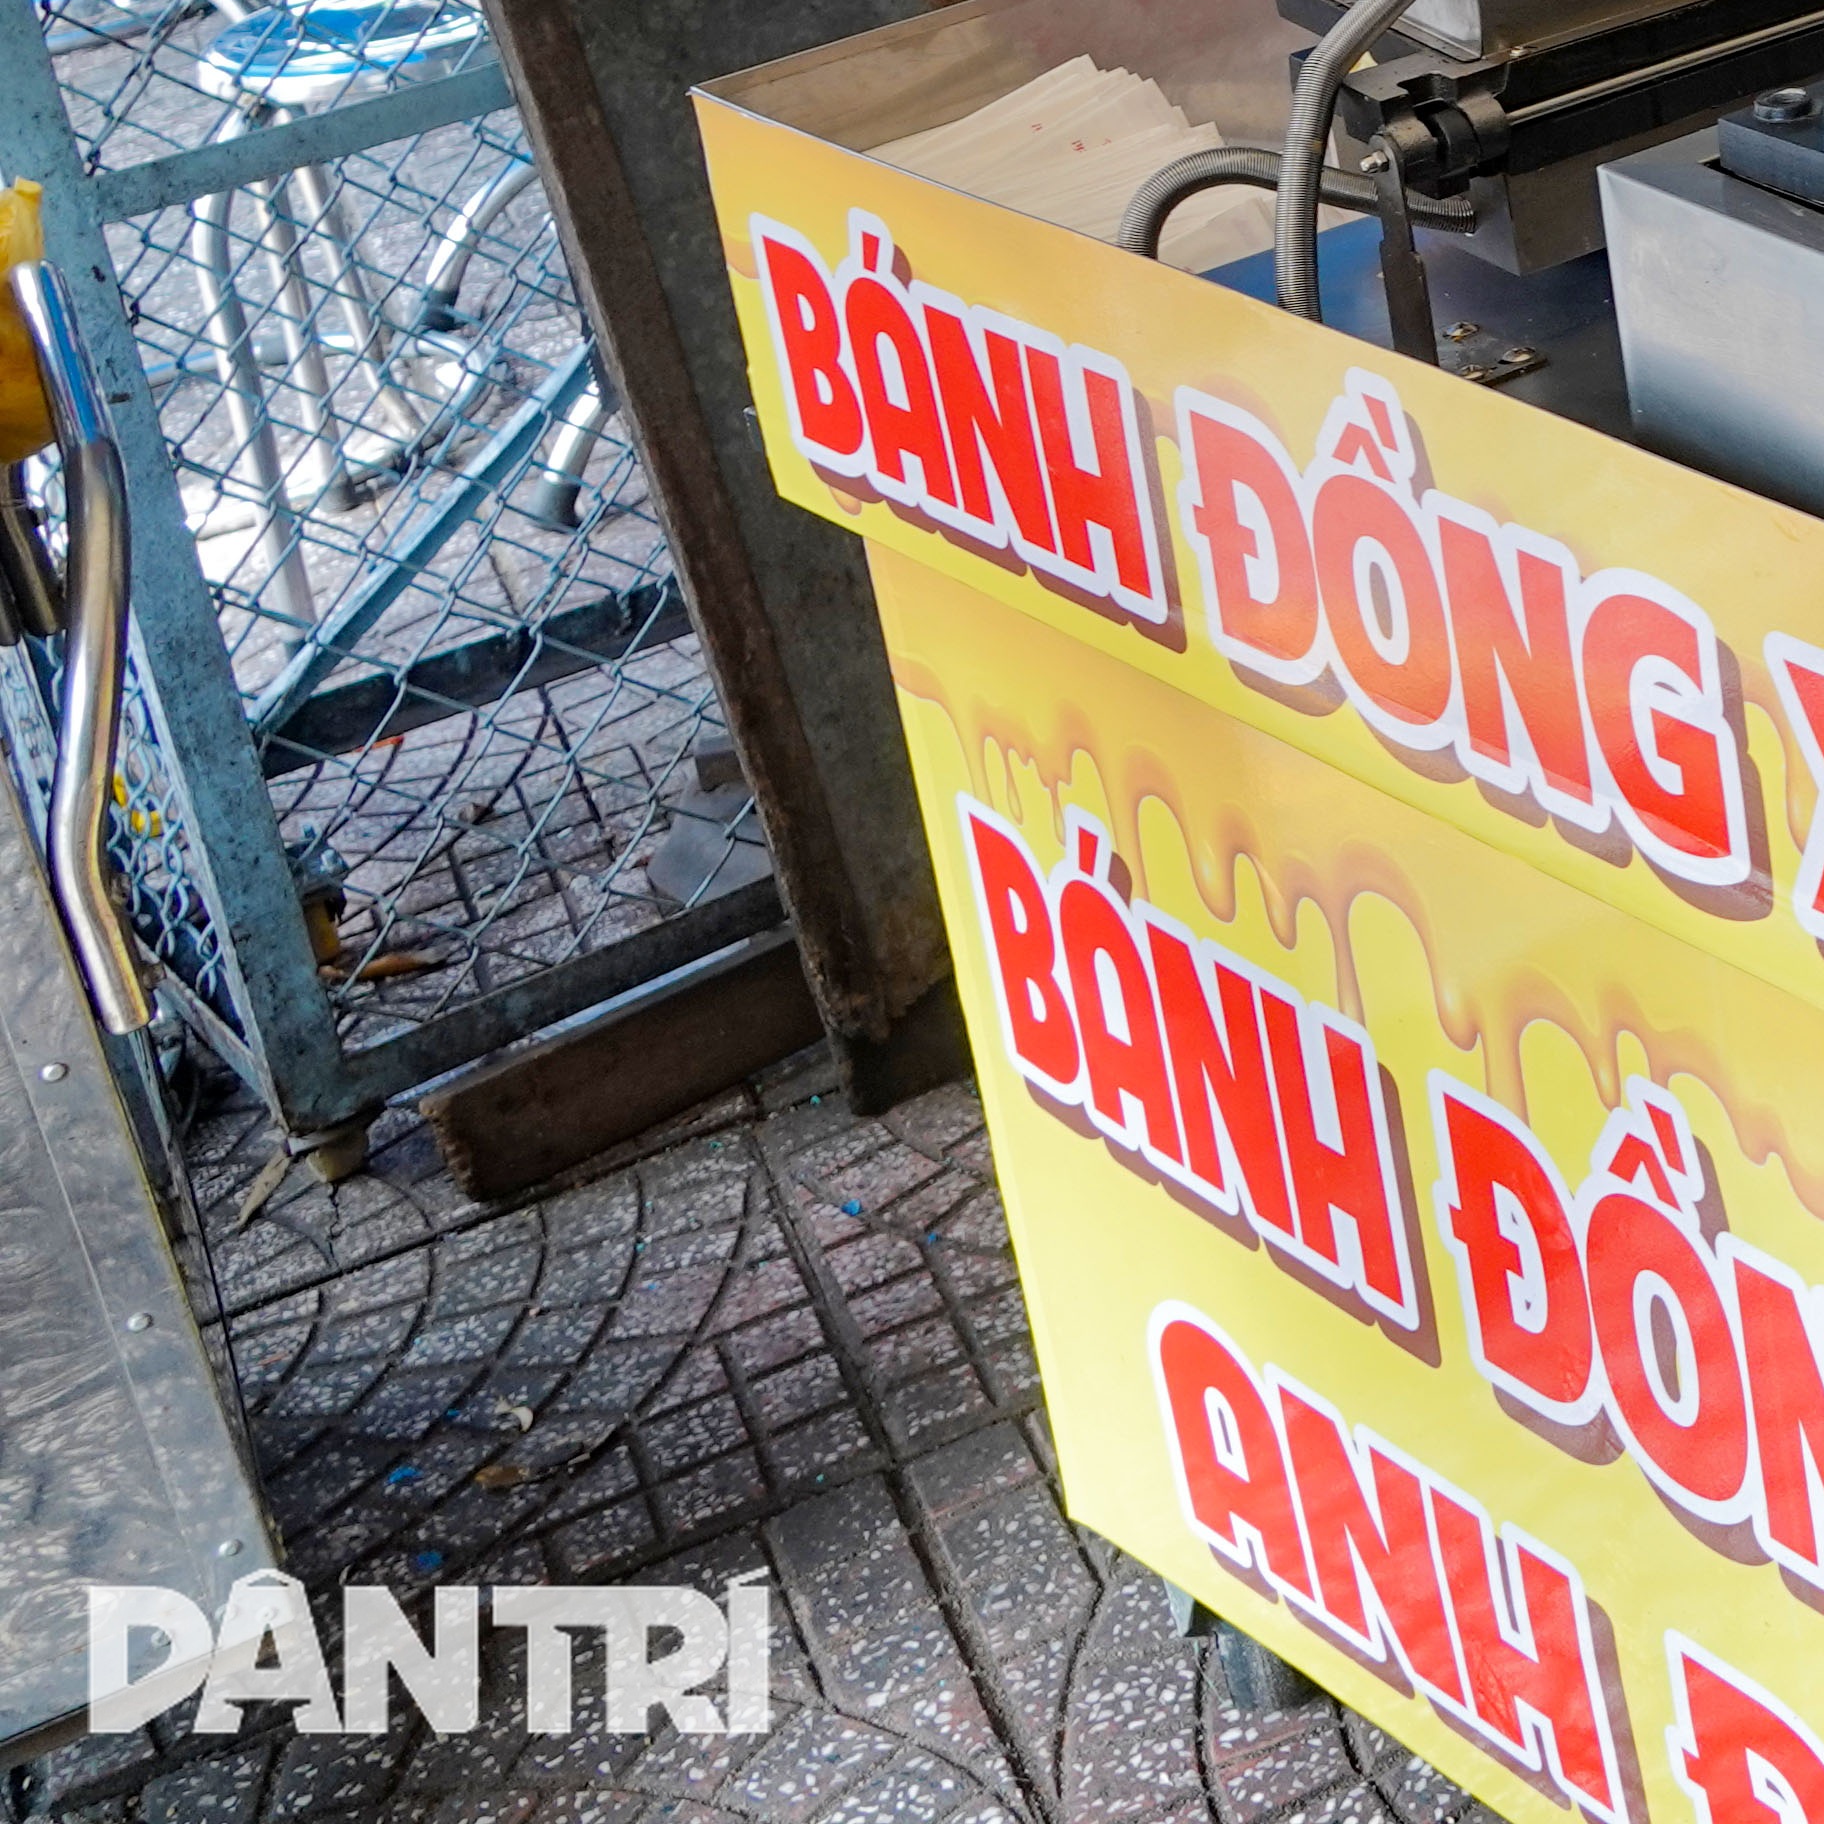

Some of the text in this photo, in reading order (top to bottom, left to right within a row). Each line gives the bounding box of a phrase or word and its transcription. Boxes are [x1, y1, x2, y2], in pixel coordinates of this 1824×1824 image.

[759, 231, 1155, 601] BÁNH
[1189, 391, 1735, 862] ĐỒNG
[967, 812, 1407, 1308] BÁNH
[1158, 1319, 1616, 1814] ANH
